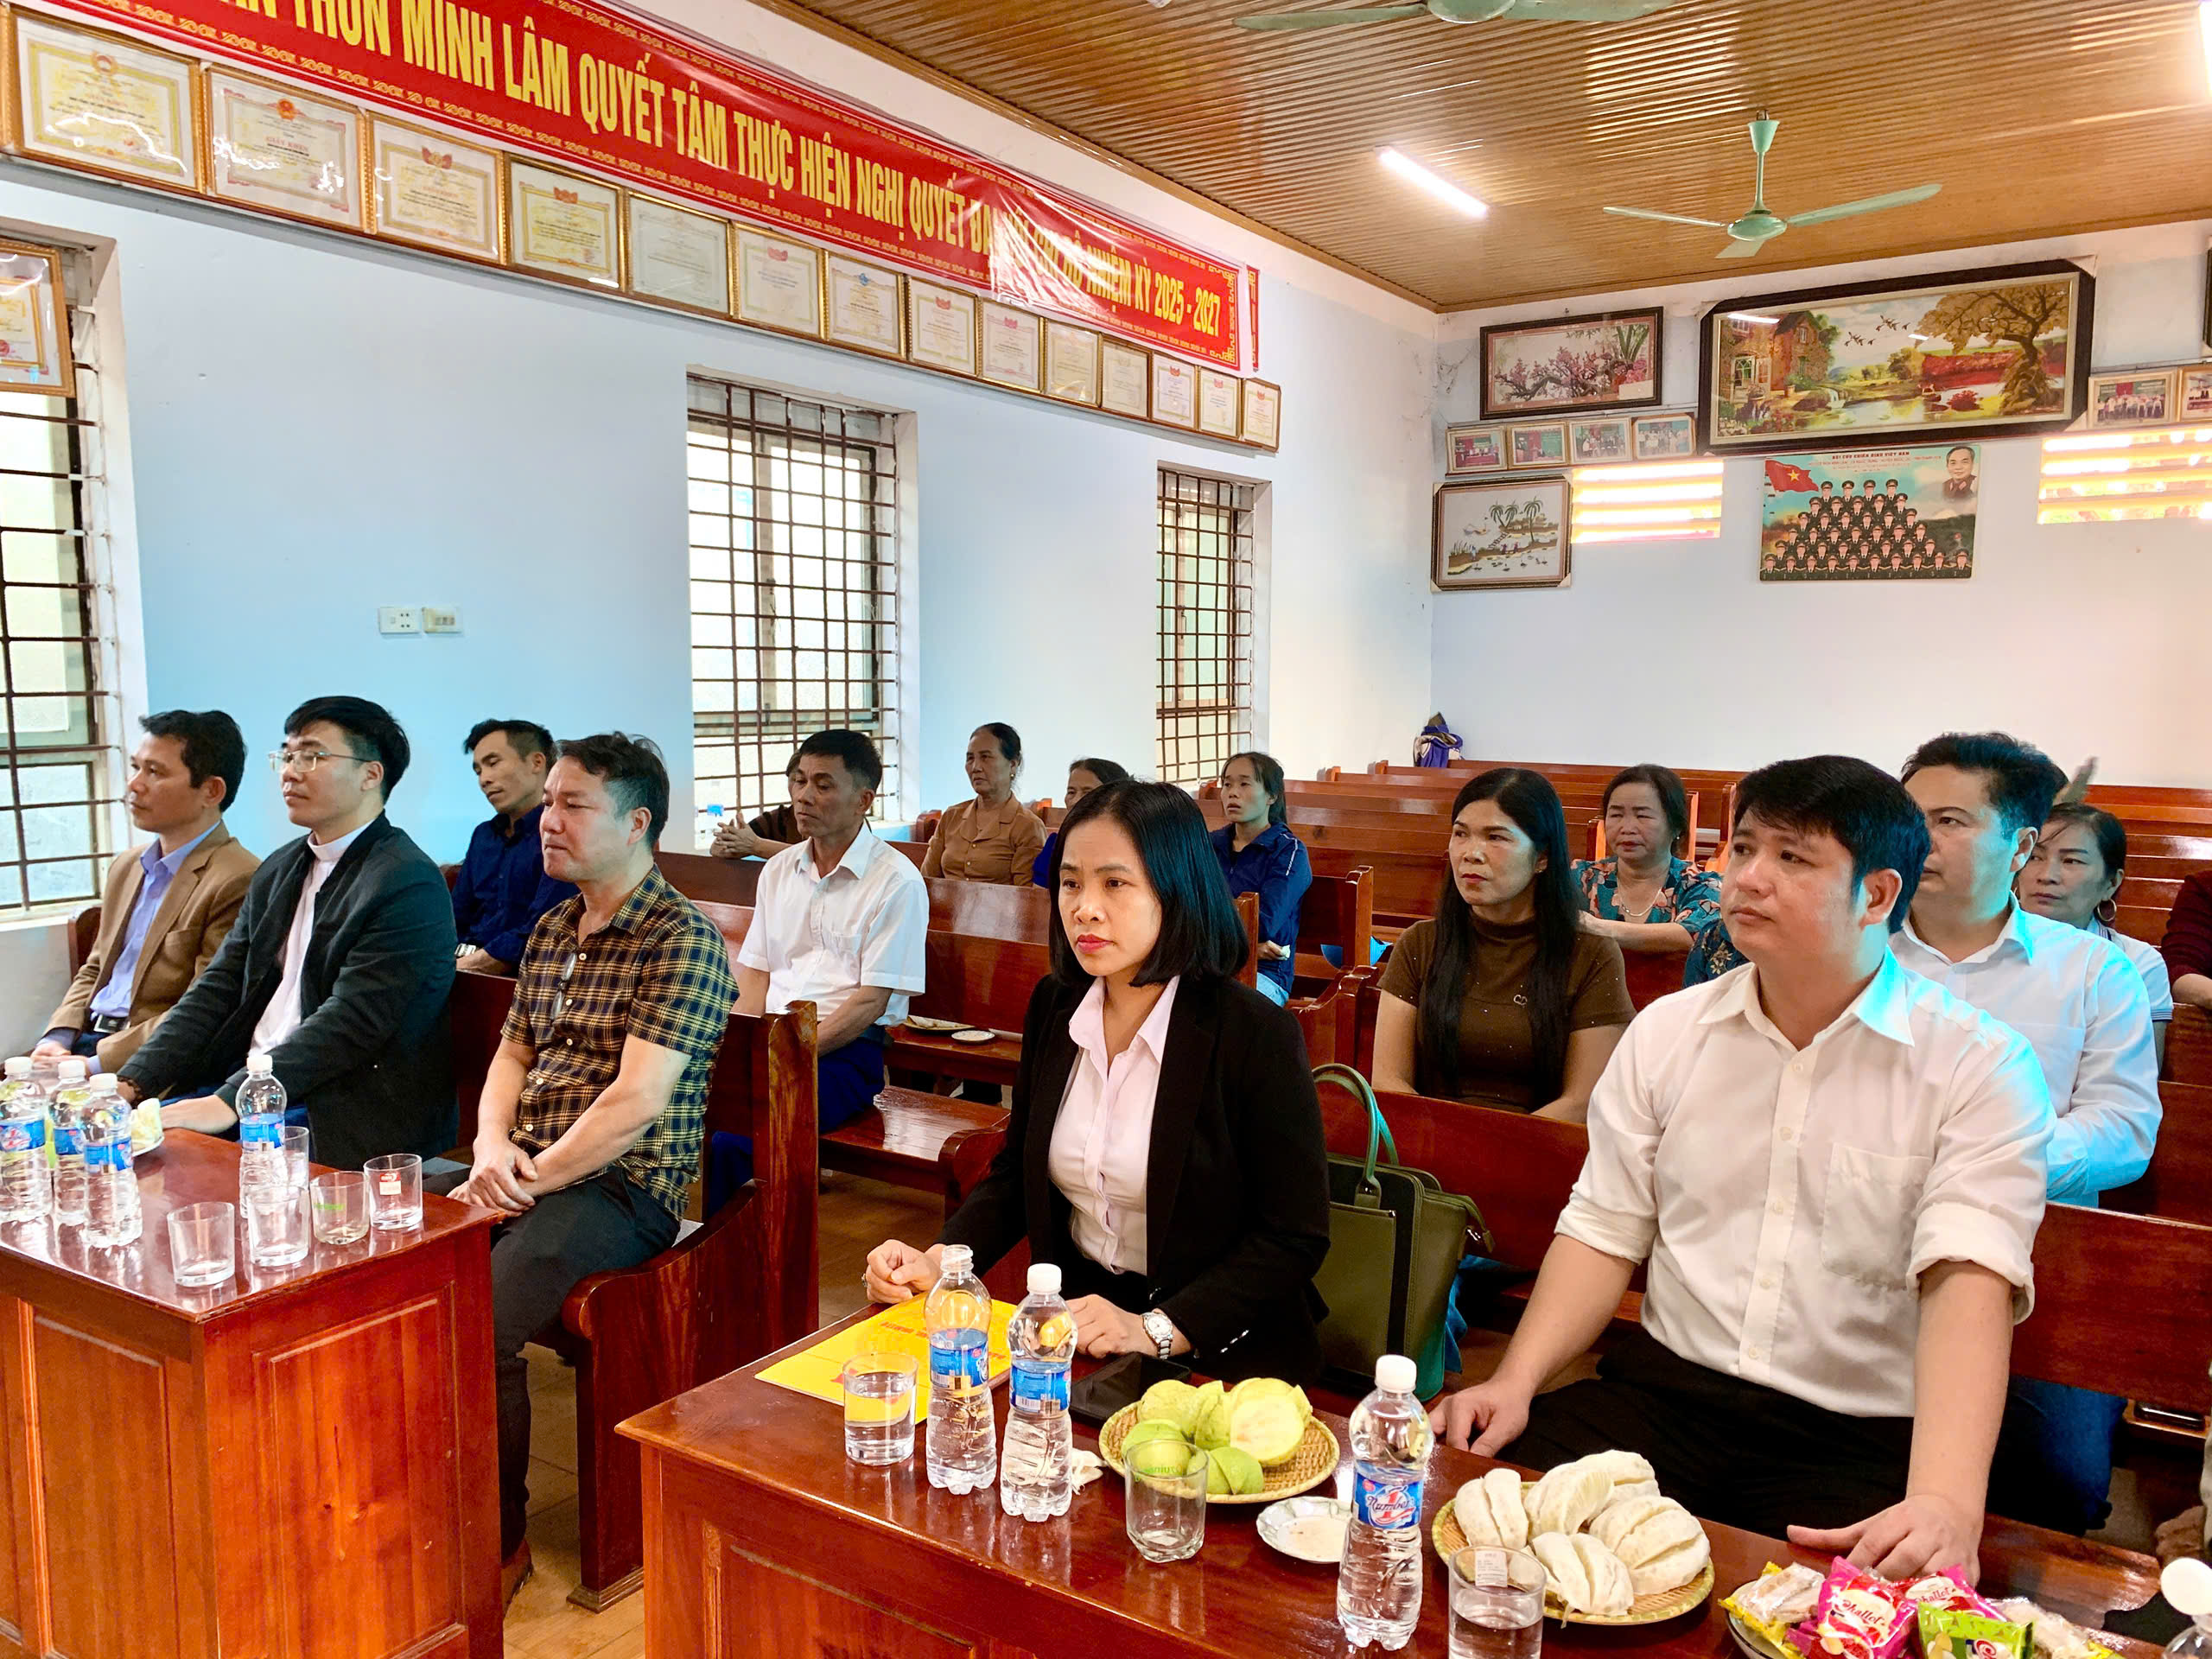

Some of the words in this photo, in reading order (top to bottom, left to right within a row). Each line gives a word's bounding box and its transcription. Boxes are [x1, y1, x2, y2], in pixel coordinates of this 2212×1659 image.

[401, 0, 495, 91] MINH
[503, 16, 571, 117] LÂM
[579, 53, 665, 148] QUYẾT
[671, 80, 728, 170] TÂM
[734, 111, 794, 200] THỰC
[800, 131, 850, 219] HIỆN
[856, 156, 905, 241] NGHỊ
[909, 172, 966, 249] QUYẾT
[1086, 244, 1132, 313] NHIỆM
[1135, 256, 1152, 314] KỲ
[1154, 271, 1184, 325] 2025
[1193, 287, 1221, 337] 2027
